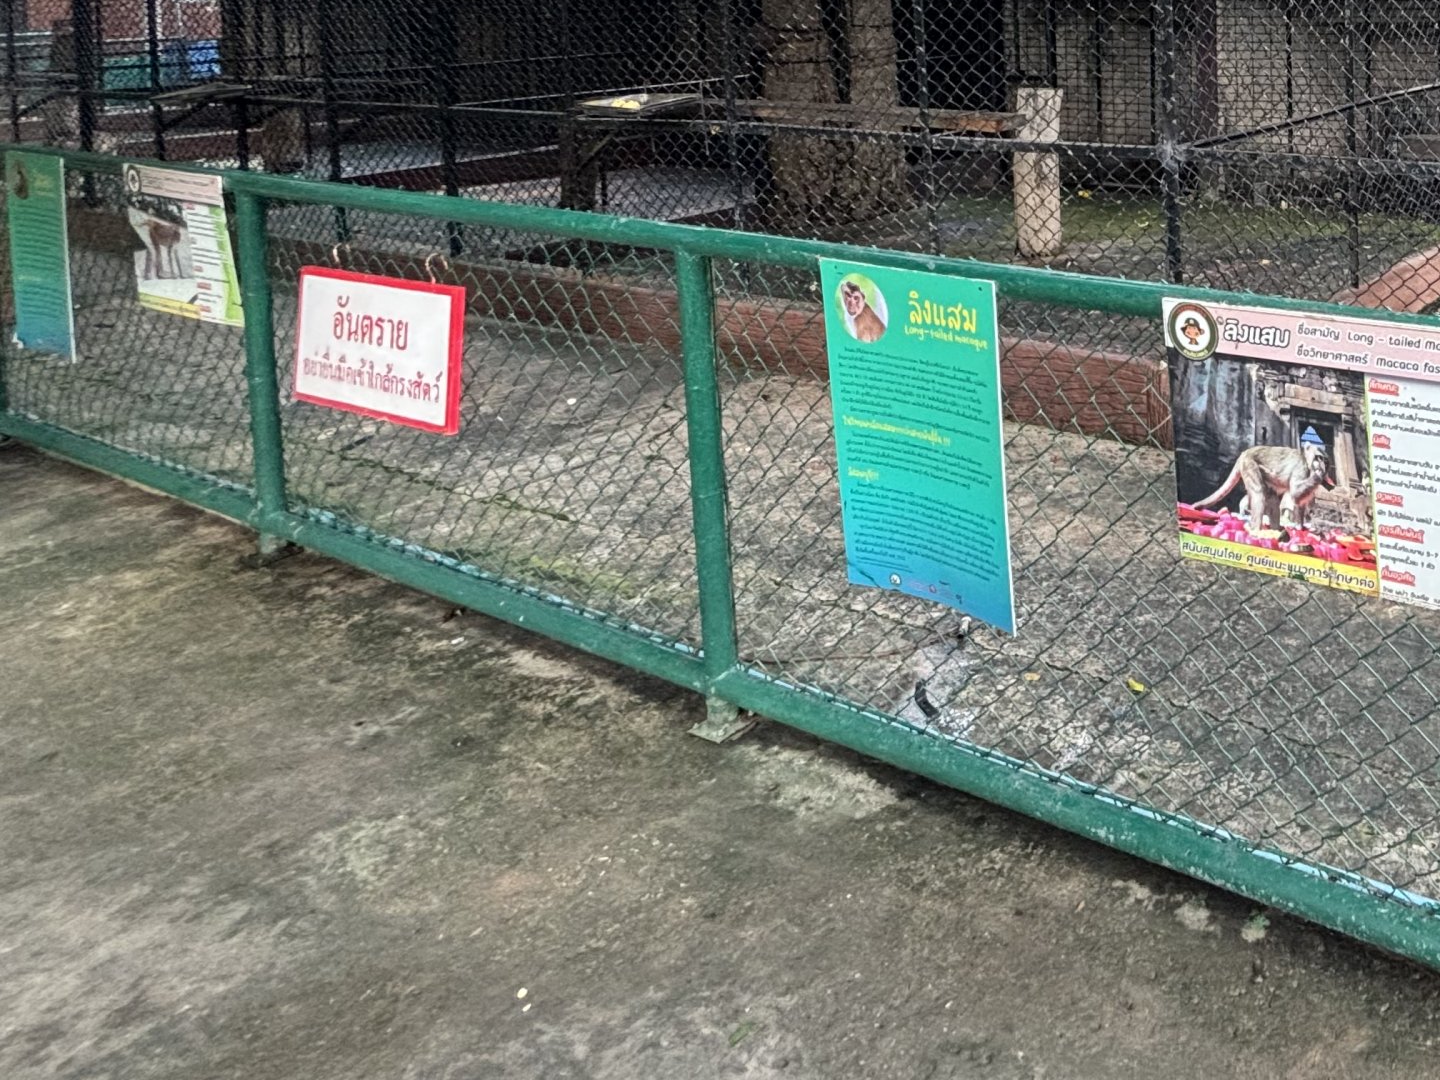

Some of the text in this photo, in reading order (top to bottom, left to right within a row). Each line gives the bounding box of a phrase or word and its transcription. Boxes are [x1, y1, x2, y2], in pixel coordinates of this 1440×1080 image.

[332, 295, 409, 351] อันตราย
[908, 290, 976, 333] ลิงแสม
[1223, 318, 1291, 349] ลิงแสม
[1297, 322, 1340, 341] ชื่อสามัญ
[1347, 331, 1374, 346] Long
[1388, 336, 1421, 349] tailed
[1296, 344, 1369, 364] ชื่อวิทยาศาสตร์
[1376, 358, 1420, 371] Macaca
[1182, 539, 1243, 561] สนับสนุนโดย
